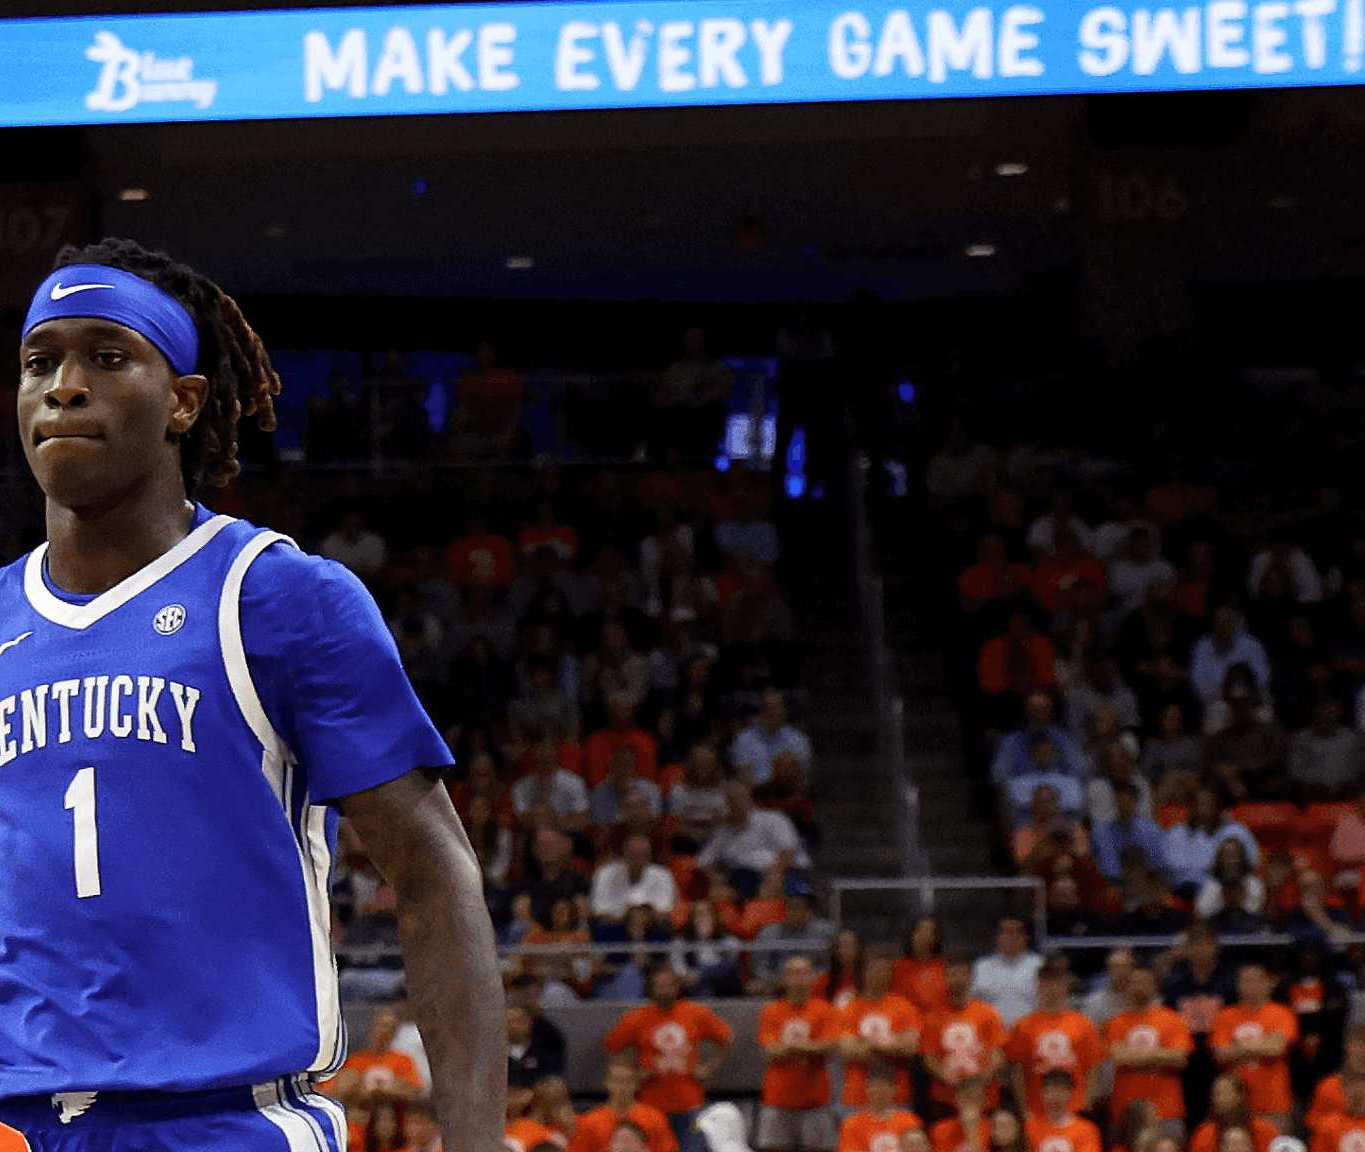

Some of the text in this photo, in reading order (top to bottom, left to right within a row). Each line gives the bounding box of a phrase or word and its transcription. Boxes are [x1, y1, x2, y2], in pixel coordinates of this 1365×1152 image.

[303, 0, 1364, 102] MAKE EVERY GAME SWEET!
[154, 605, 184, 633] SEC
[64, 767, 101, 898] 1
